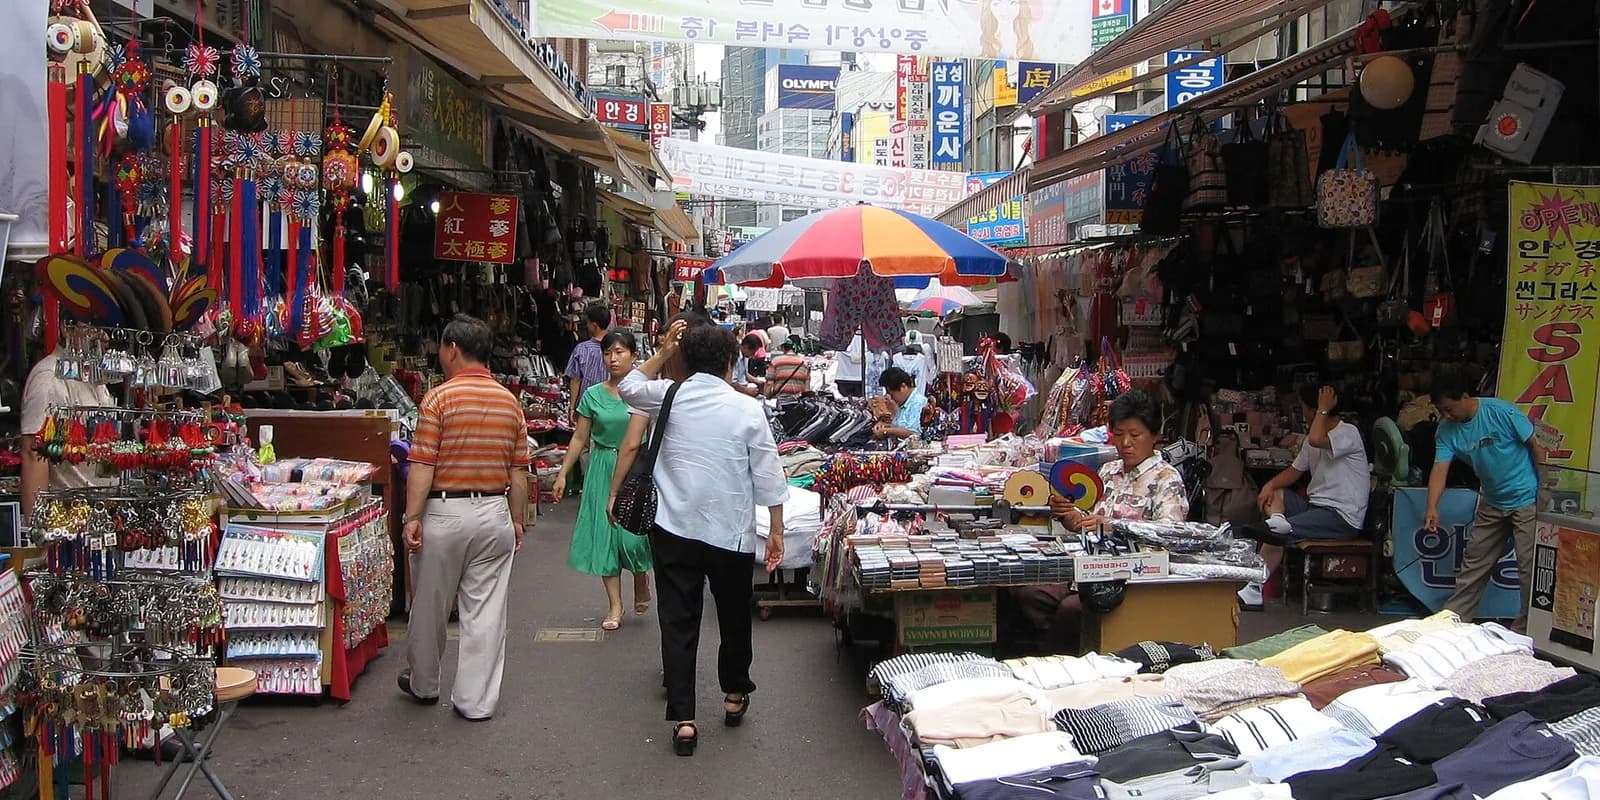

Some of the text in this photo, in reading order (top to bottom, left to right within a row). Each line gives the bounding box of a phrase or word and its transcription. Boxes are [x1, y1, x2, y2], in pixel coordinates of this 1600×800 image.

[782, 78, 838, 90] OLYMPU
[1024, 68, 1052, 88] 店
[605, 101, 639, 122] 안경
[934, 64, 964, 160] 삼성 까운사
[1520, 201, 1600, 233] OPEN
[1518, 239, 1600, 260] 안경
[1518, 261, 1598, 278] メガネ
[1515, 280, 1599, 301] 썬그라스
[1514, 303, 1595, 322] サングラス
[1536, 569, 1554, 594] LOOP
